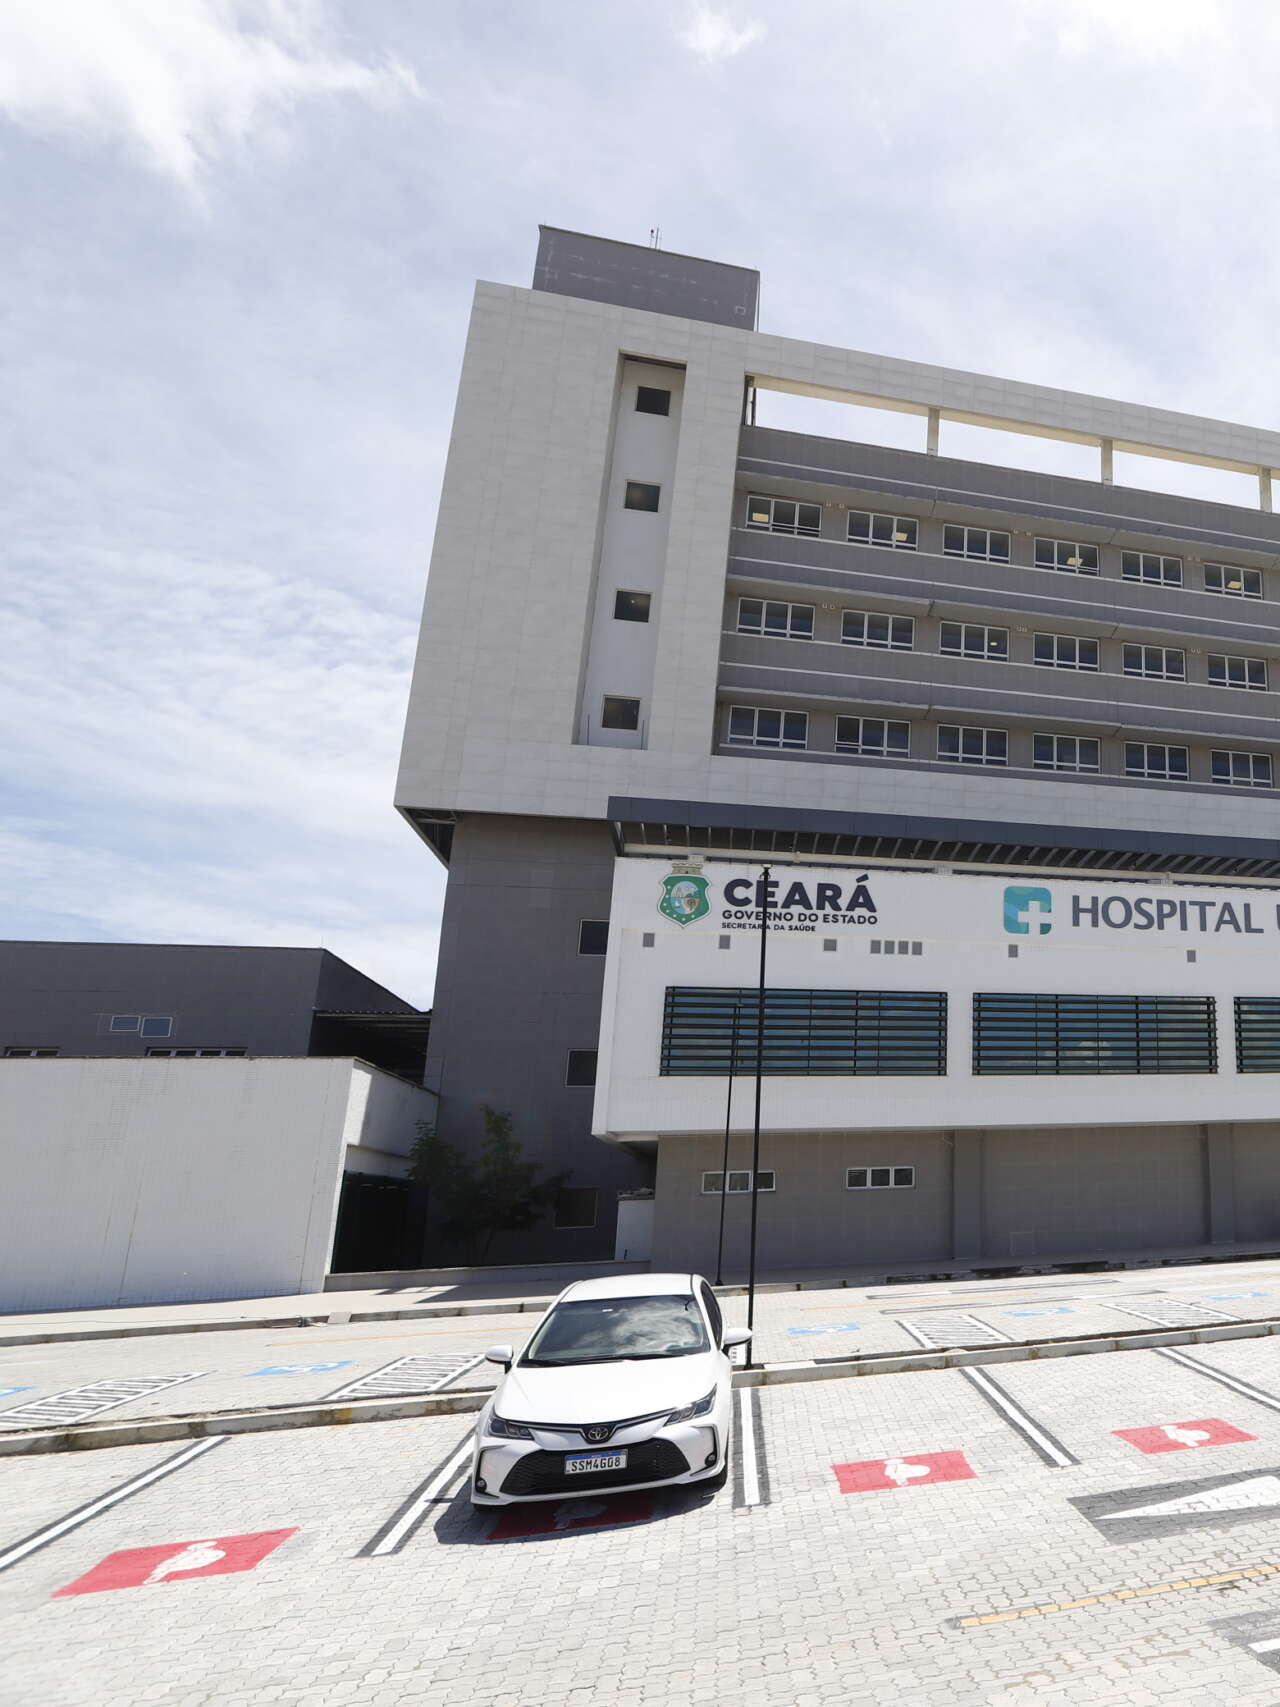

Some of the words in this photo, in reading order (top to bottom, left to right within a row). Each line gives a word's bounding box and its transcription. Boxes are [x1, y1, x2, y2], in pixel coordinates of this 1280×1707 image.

[723, 873, 877, 913] CEARÁ
[721, 909, 794, 923] GOVERNO
[797, 912, 819, 923] DO
[822, 913, 878, 926] ESTADO
[721, 922, 771, 931] SECRETARA
[788, 923, 816, 932] SAÚDE
[1071, 894, 1264, 935] HOSPITAL
